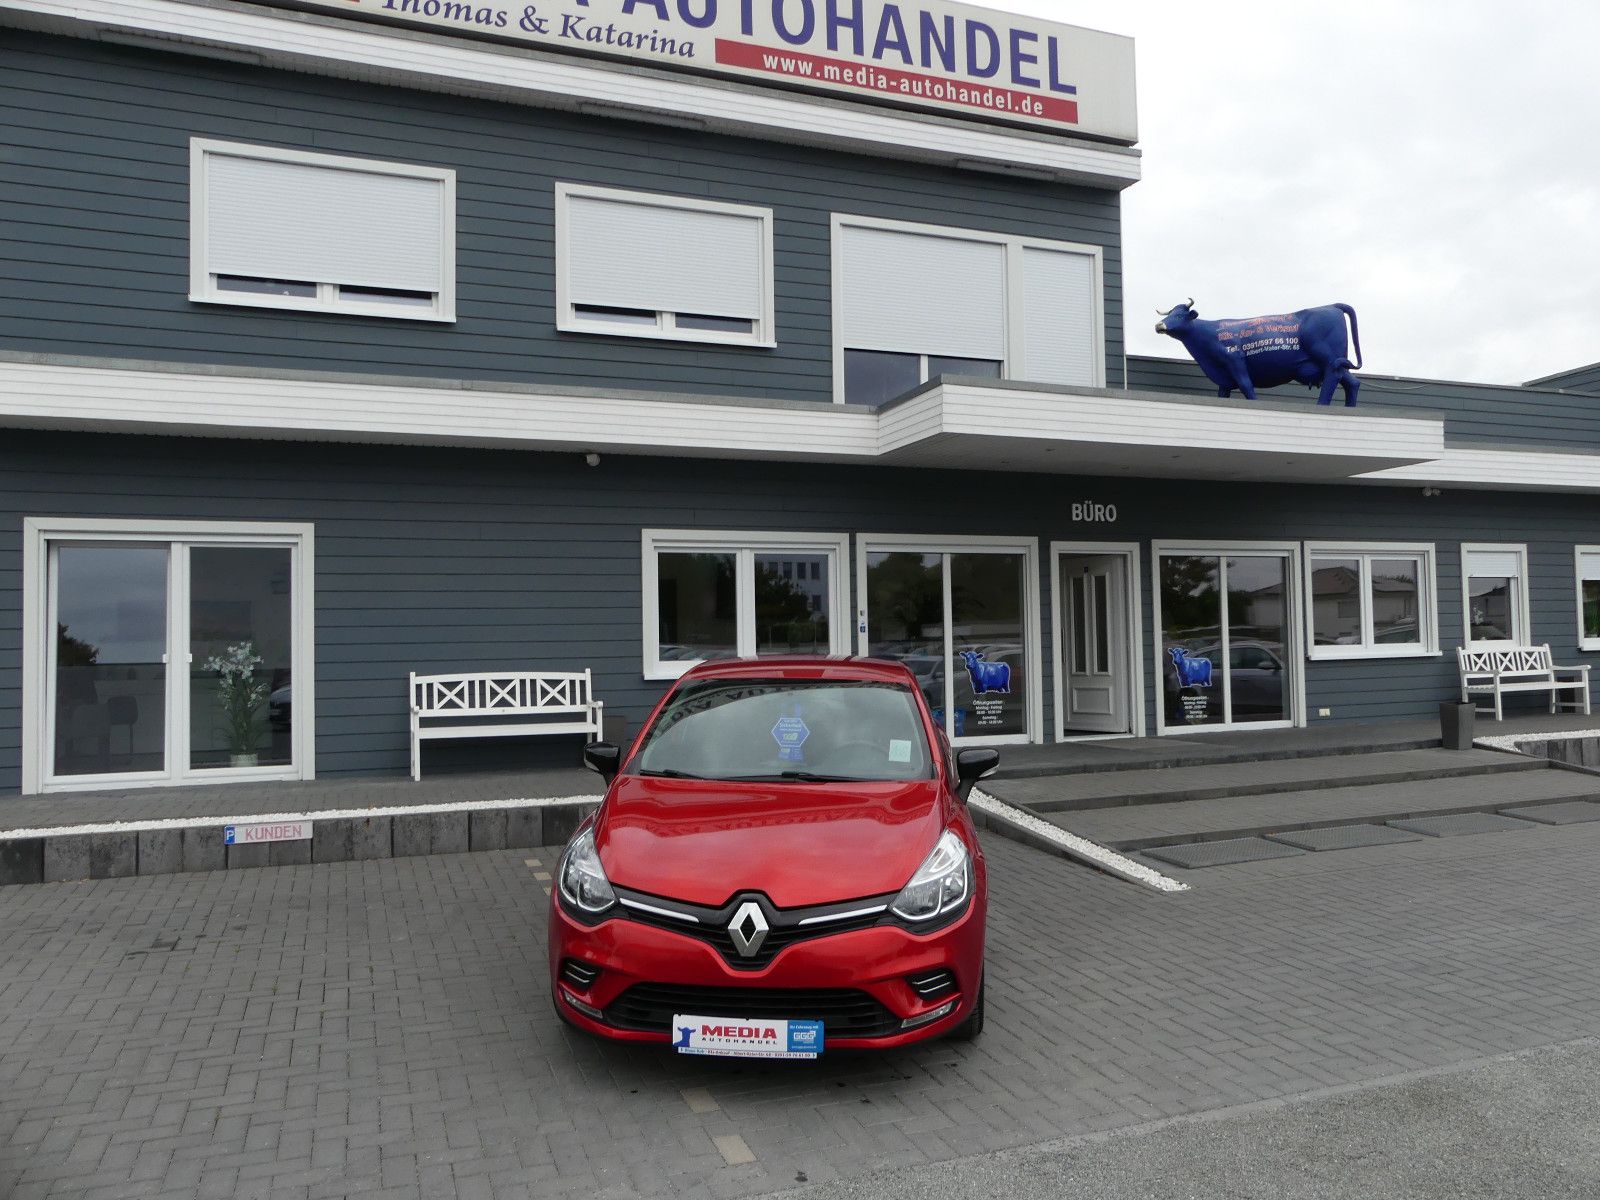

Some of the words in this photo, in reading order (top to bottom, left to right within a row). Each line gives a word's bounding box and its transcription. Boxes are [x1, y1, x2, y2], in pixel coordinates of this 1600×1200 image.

[519, 5, 549, 35] &
[559, 13, 695, 58] Katarina
[763, 51, 1044, 116] www.media-autohandel.de
[1226, 345, 1240, 353] Tel.
[1072, 500, 1117, 522] BÜRO
[226, 829, 235, 840] P
[245, 824, 302, 841] KUNDEN
[701, 1024, 777, 1039] MEDIA
[701, 1037, 777, 1045] AUTOHANDEL
